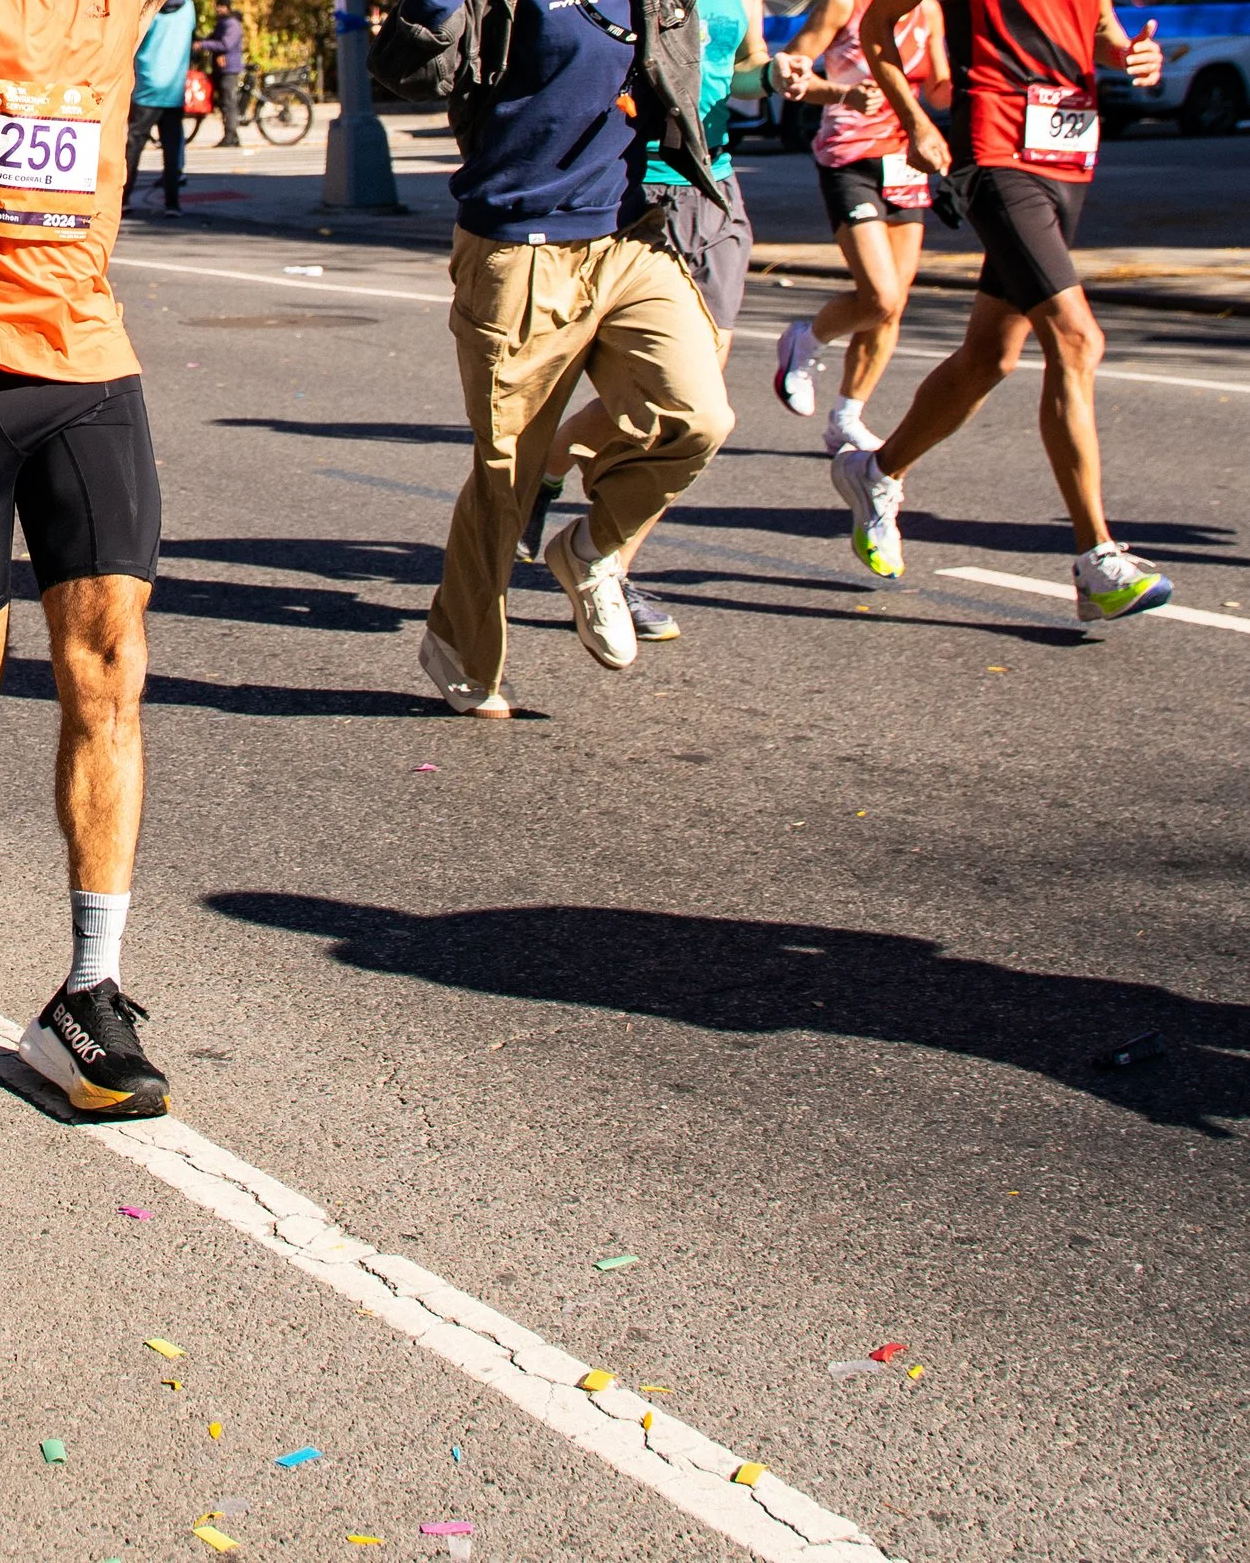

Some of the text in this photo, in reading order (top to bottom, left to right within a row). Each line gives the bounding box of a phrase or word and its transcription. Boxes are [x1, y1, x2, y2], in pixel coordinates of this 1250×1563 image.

[45, 175, 52, 185] B
[42, 213, 76, 228] 2024
[53, 1002, 106, 1064] BROOKS
